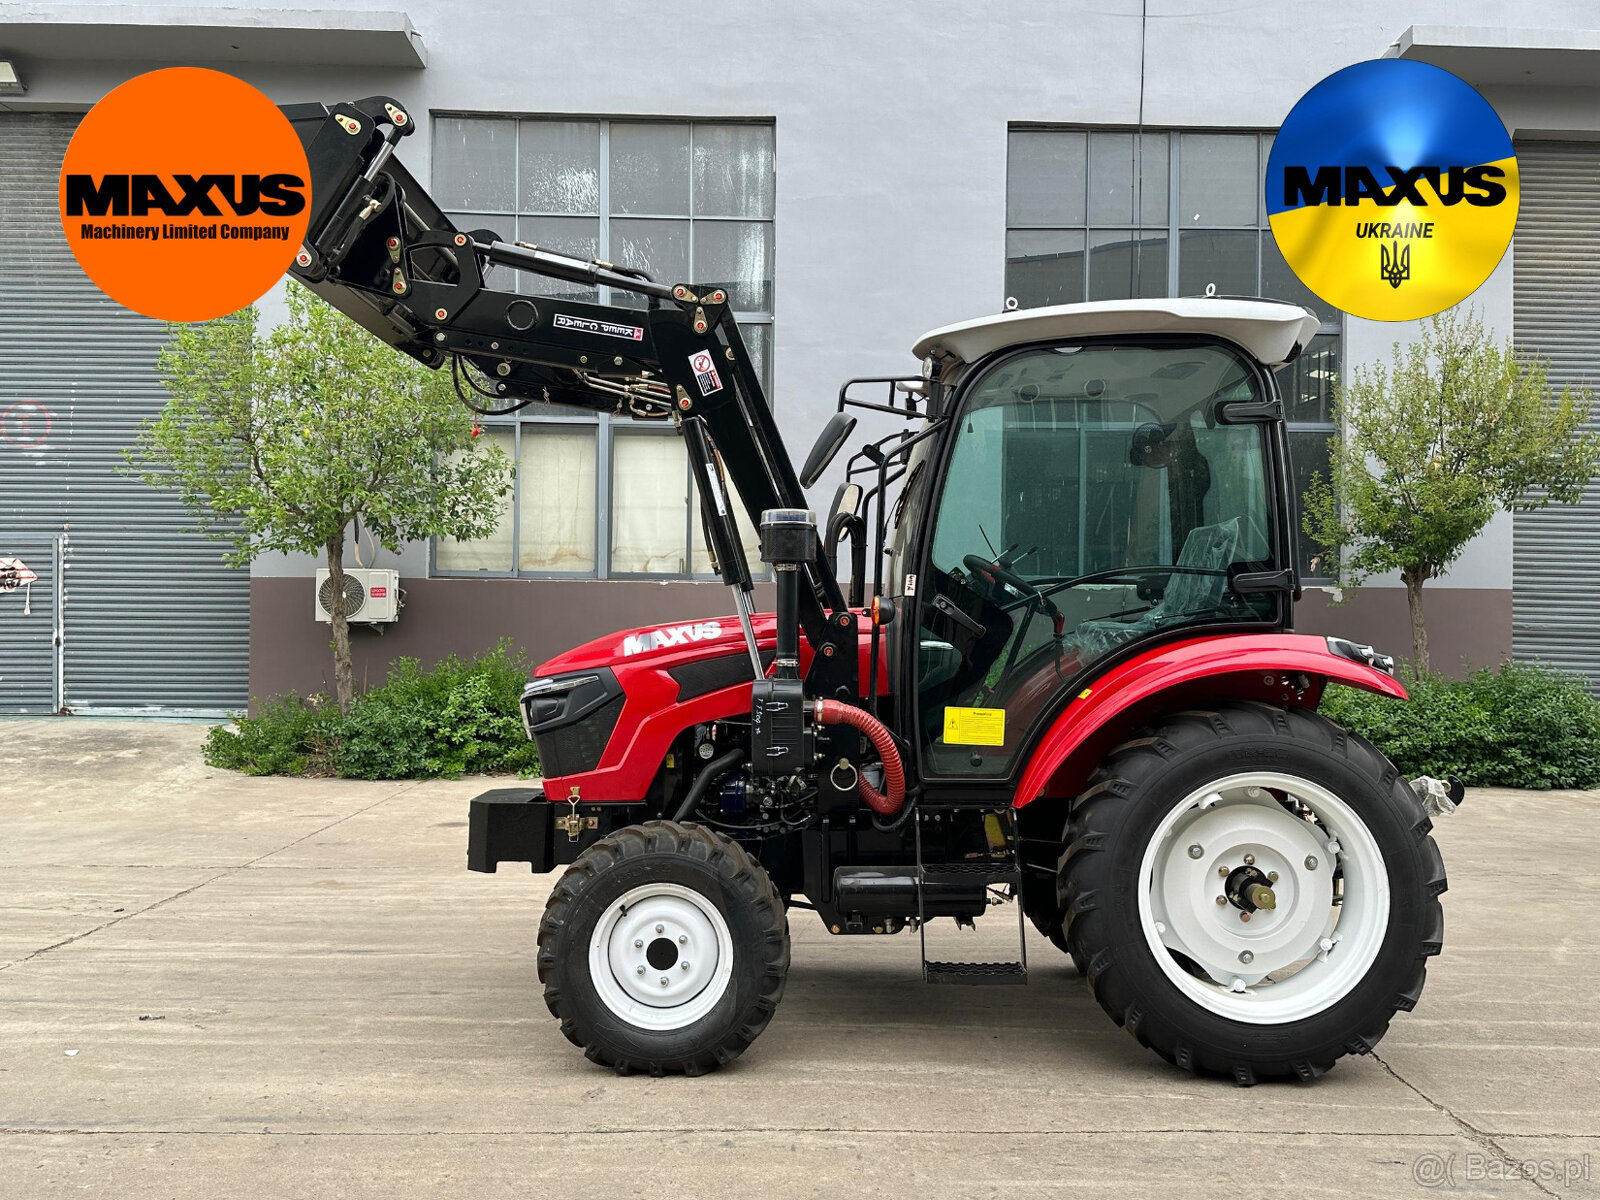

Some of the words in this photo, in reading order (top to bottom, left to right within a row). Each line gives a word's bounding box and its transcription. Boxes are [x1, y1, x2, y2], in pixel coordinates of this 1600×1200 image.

[556, 316, 599, 332] CLEAR
[600, 323, 634, 338] KEEP
[623, 621, 723, 657] MAXUS
